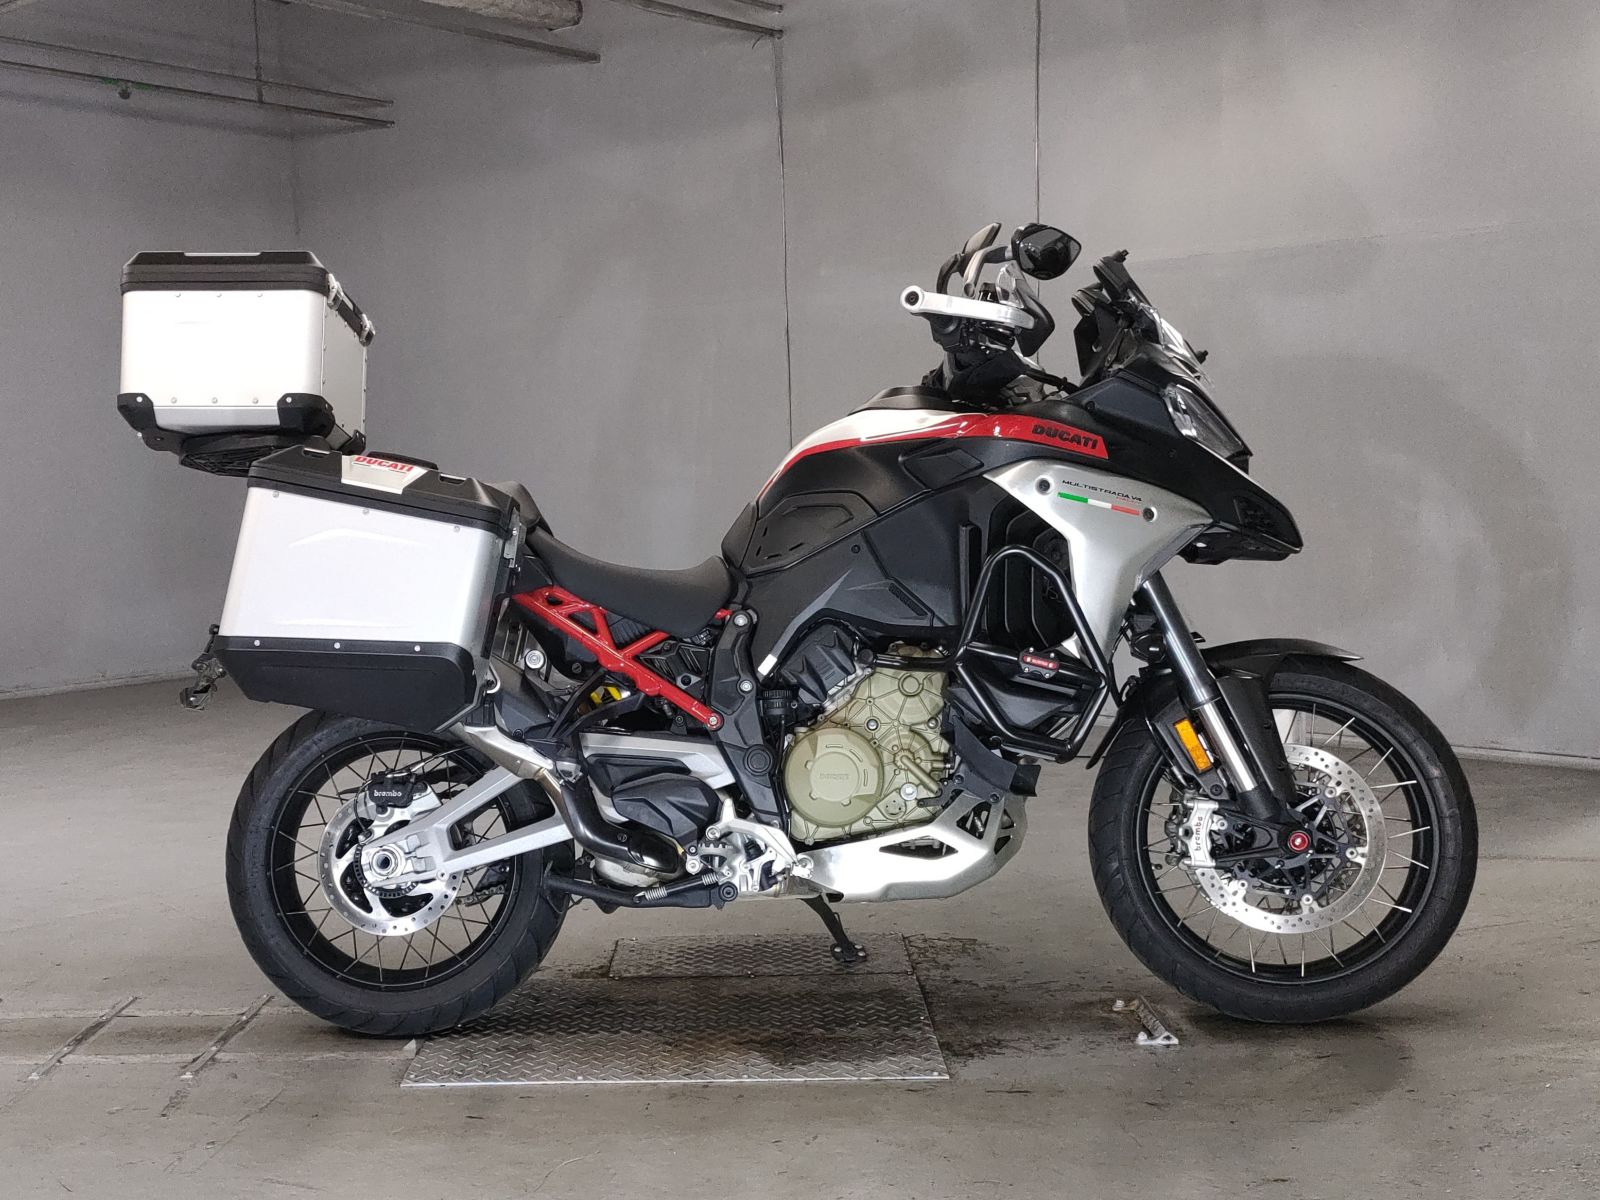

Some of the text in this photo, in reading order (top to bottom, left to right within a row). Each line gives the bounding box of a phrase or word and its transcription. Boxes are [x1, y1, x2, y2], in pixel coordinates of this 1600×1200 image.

[1032, 424, 1098, 449] DUCATI
[354, 456, 414, 472] DUCATI
[373, 789, 402, 797] brembo
[1194, 816, 1203, 851] brembo
